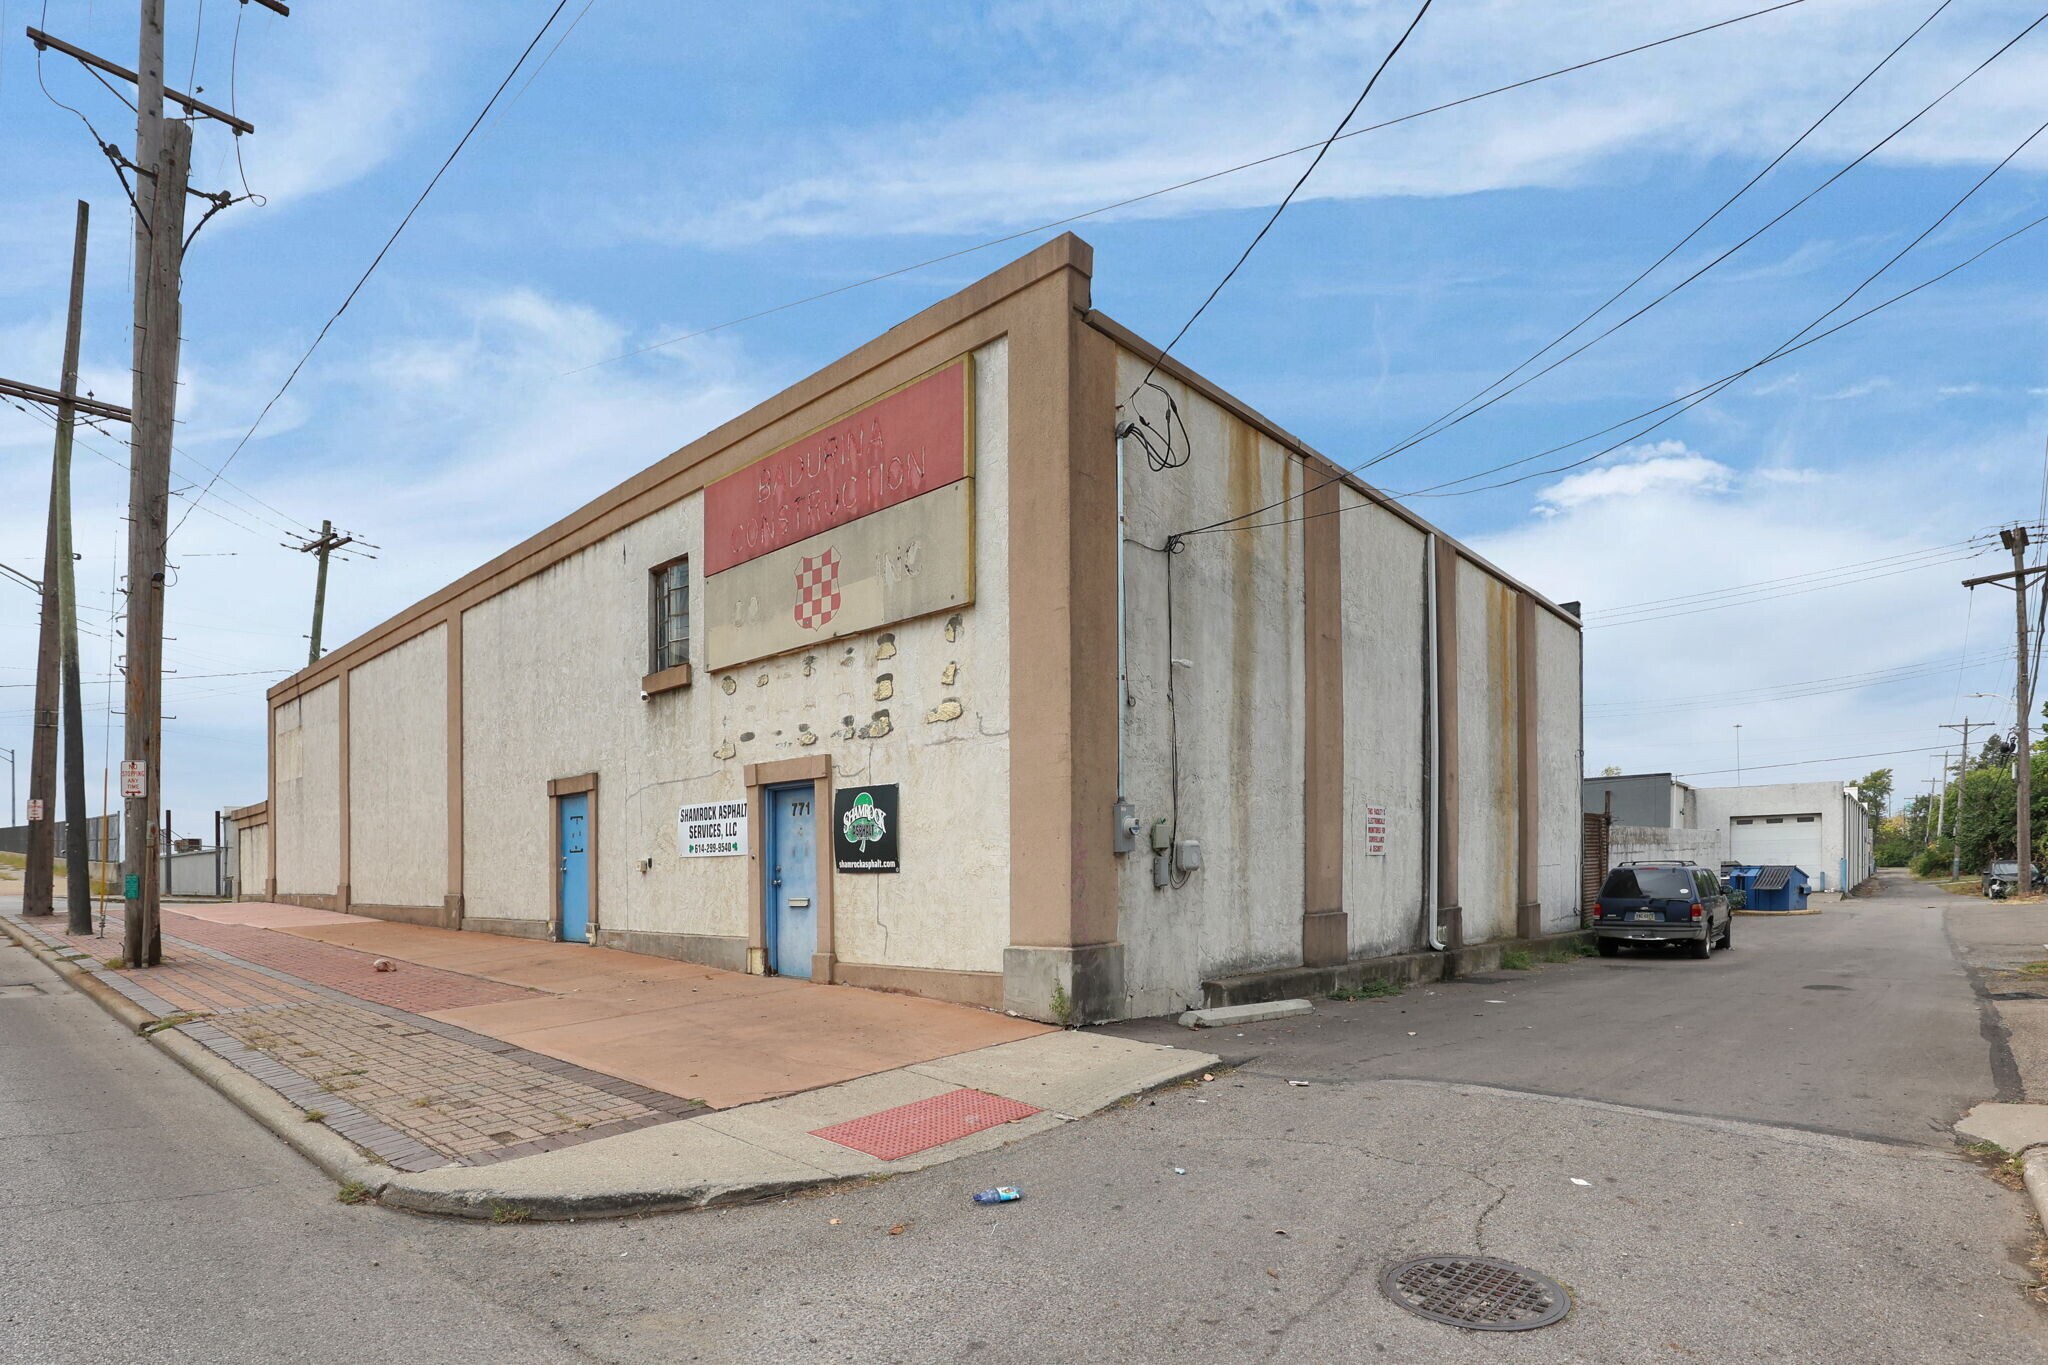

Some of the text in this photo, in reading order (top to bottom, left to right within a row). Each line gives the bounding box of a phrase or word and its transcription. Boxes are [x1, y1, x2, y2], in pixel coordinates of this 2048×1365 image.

[731, 446, 926, 553] CONSTRUCTION
[680, 803, 747, 823] SHAMROCK ASPHALT
[791, 801, 810, 816] 771
[843, 804, 886, 833] SHAMROCK
[689, 822, 738, 840] SERVICES, LLC
[838, 860, 896, 870] shamrockasphalt.com
